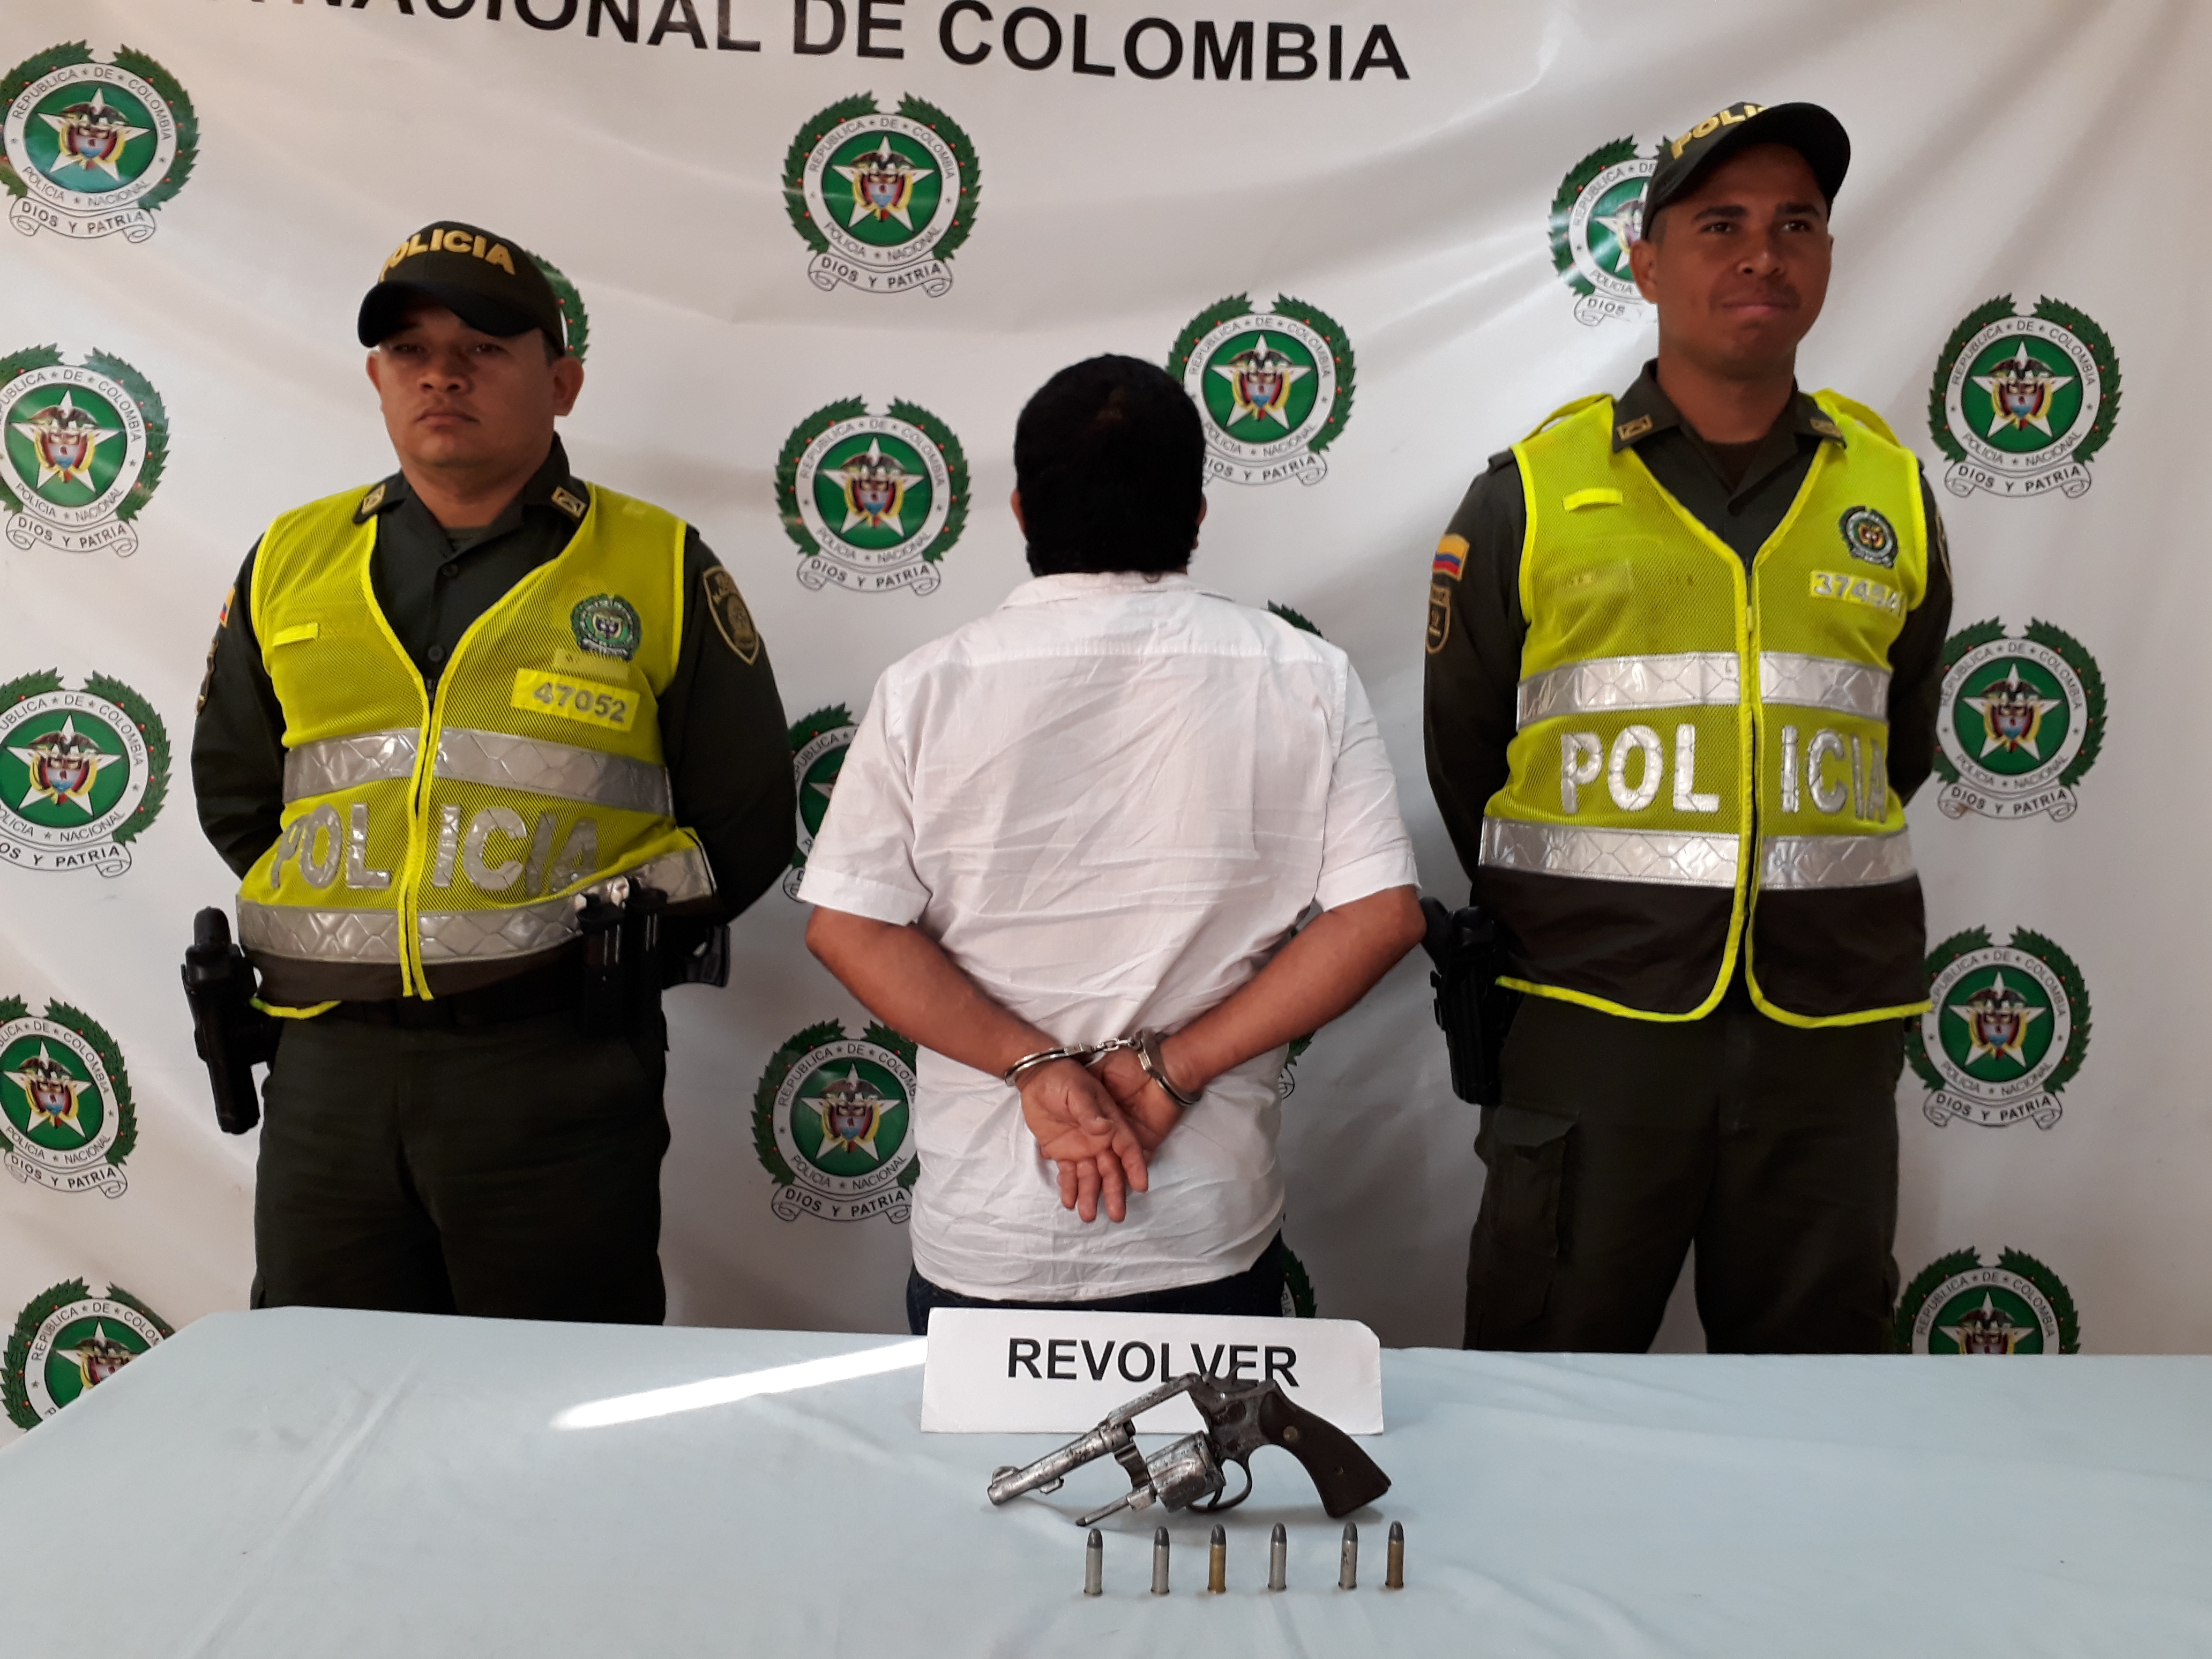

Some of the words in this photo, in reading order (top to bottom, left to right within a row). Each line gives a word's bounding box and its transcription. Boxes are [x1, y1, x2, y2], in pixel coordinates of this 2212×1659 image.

[794, 0, 905, 59] DE
[939, 0, 1410, 81] COLOMBIA
[12, 69, 78, 119] REPUBLICA
[94, 68, 114, 79] DE
[128, 79, 171, 140] COLOMBIA
[808, 122, 865, 172] REPUBLICA
[879, 118, 897, 128] DE
[23, 166, 65, 201] POLICIA
[88, 181, 149, 206] NACIONAL
[23, 201, 57, 226] DIOS
[69, 221, 78, 233] Y
[88, 212, 144, 233] PATRIA
[821, 257, 857, 282] DIOS
[869, 277, 877, 287] Y
[888, 263, 940, 288] PATRIA
[1587, 297, 1625, 315] DIOS
[1952, 326, 2002, 385] REPUBLICA
[2017, 321, 2034, 331] DE
[2049, 328, 2095, 385] COLOMBIA
[64, 369, 83, 380] DE
[99, 381, 141, 442] COLOMBIA
[2025, 432, 2082, 466] NACIONAL
[1207, 459, 1233, 476] IOS
[1244, 471, 1251, 480] Y
[1262, 456, 1316, 480] PATRIA
[1959, 466, 1994, 488] DIOS
[2005, 482, 2014, 491] Y
[2025, 466, 2080, 492] PATRIA
[16, 483, 56, 518] POLICIA
[18, 517, 53, 541] DIOS
[62, 537, 70, 547] Y
[80, 524, 126, 548] PATRIA
[811, 559, 846, 581] DIOS
[858, 577, 865, 587] Y
[876, 565, 930, 587] PATRIA
[533, 682, 626, 722] 47052
[64, 695, 83, 706] DE
[99, 706, 143, 765] COLOMBIA
[1951, 788, 1985, 809] DIOS
[1994, 803, 2002, 813] Y
[2014, 790, 2066, 814] PATRIA
[0, 809, 33, 837] OLICIA
[60, 811, 125, 842] NACIONAL
[33, 854, 42, 865] Y
[56, 846, 119, 867] PATRIA
[778, 1048, 833, 1107] REPUBLICA
[848, 1044, 865, 1055] DE
[1937, 1094, 1971, 1116] DIOS
[1983, 1110, 1991, 1120] Y
[2000, 1095, 2051, 1120] PATRIA
[5, 1126, 46, 1159] POLICIA
[64, 1135, 111, 1164] NACIONAL
[11, 1155, 42, 1179] DIOS
[51, 1177, 59, 1186] Y
[68, 1167, 117, 1189] PATRIA
[791, 1156, 830, 1188] POLICIA
[852, 1155, 907, 1190] NACIONAL
[784, 1189, 822, 1212] DIOS
[831, 1206, 841, 1216] Y
[850, 1190, 906, 1216] PATRIA
[1983, 1272, 1999, 1281] DE
[2013, 1279, 2056, 1337] COLOMBIA
[32, 1306, 79, 1362] REPUBLICA
[93, 1302, 110, 1313] DE
[1008, 1337, 1300, 1387] REVOLVER
